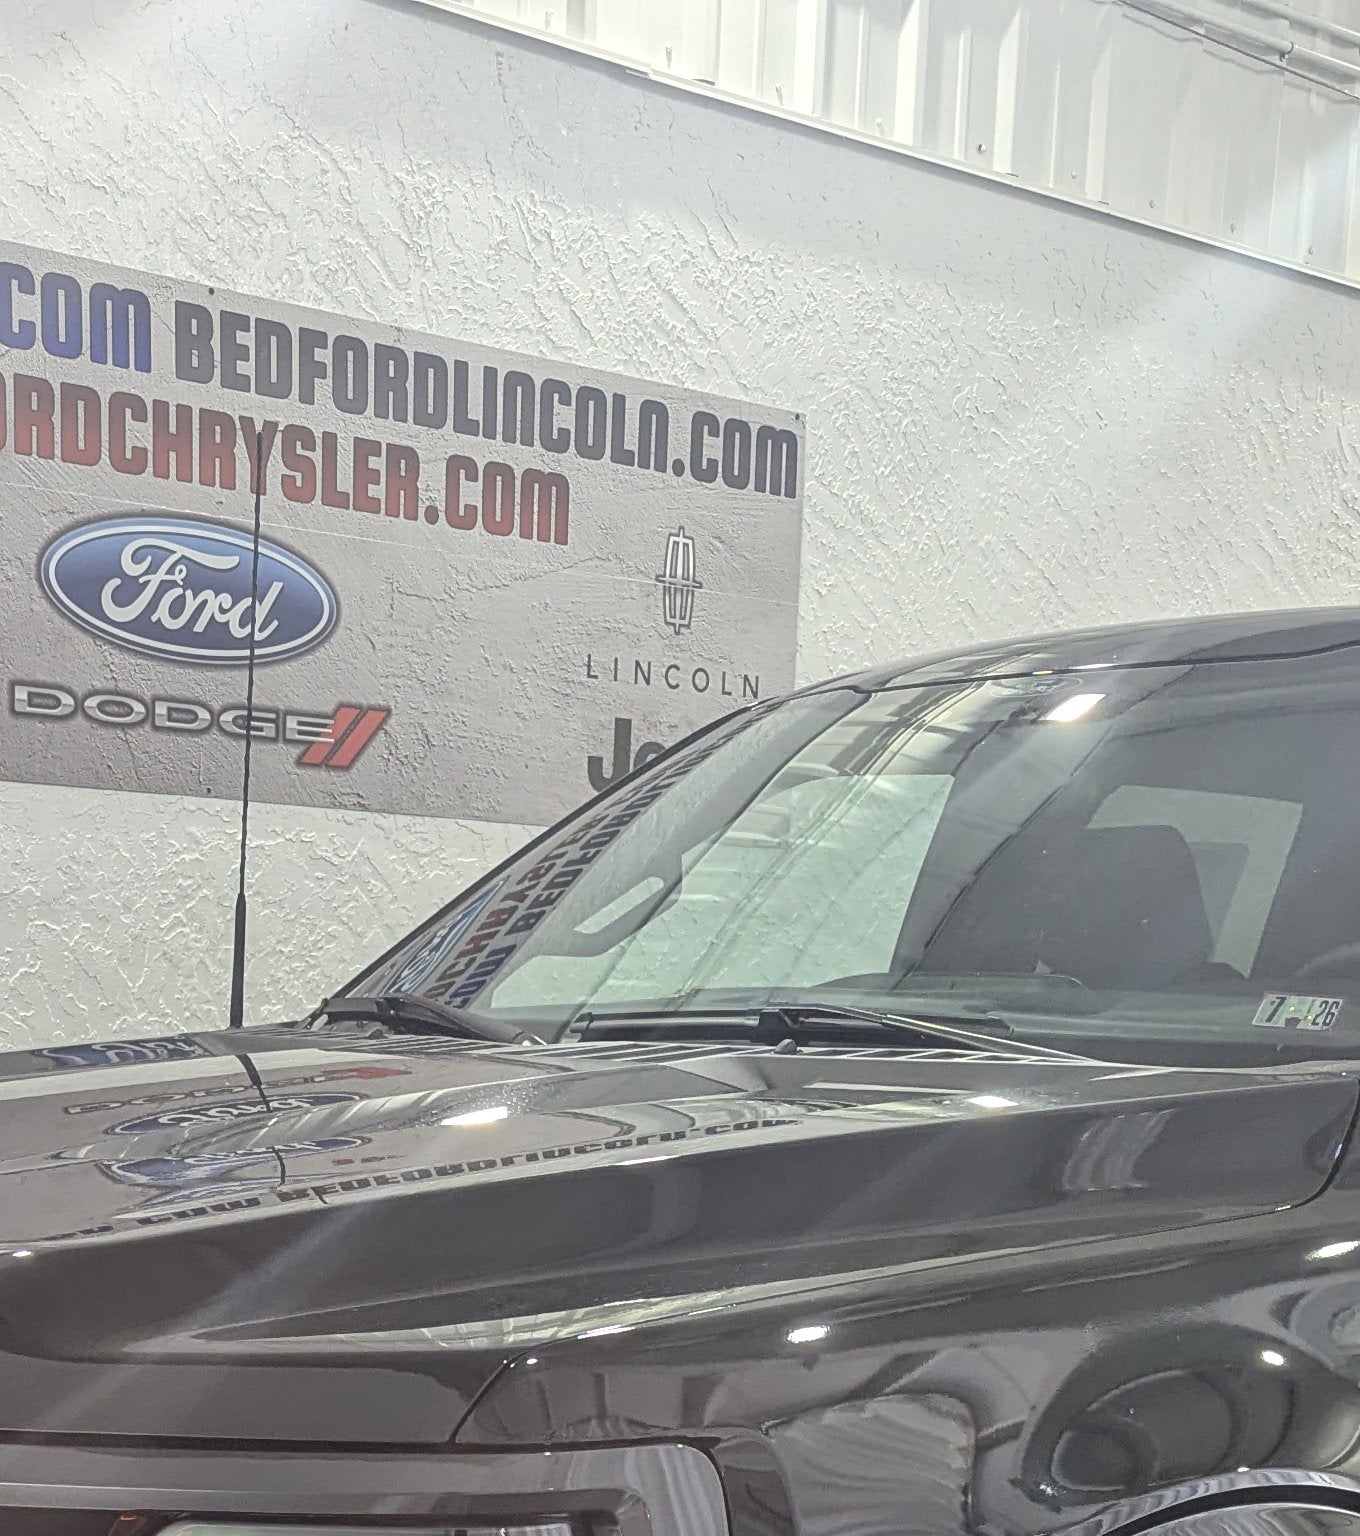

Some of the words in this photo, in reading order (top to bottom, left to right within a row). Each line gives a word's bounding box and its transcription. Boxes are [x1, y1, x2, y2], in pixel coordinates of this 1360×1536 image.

[175, 302, 798, 499] BEDFORDLINCOLN.COM
[101, 538, 284, 641] Ford
[586, 653, 759, 699] LINCOLN
[14, 685, 335, 743] DODGE
[1265, 996, 1287, 1023] 7
[1311, 1000, 1340, 1026] 26
